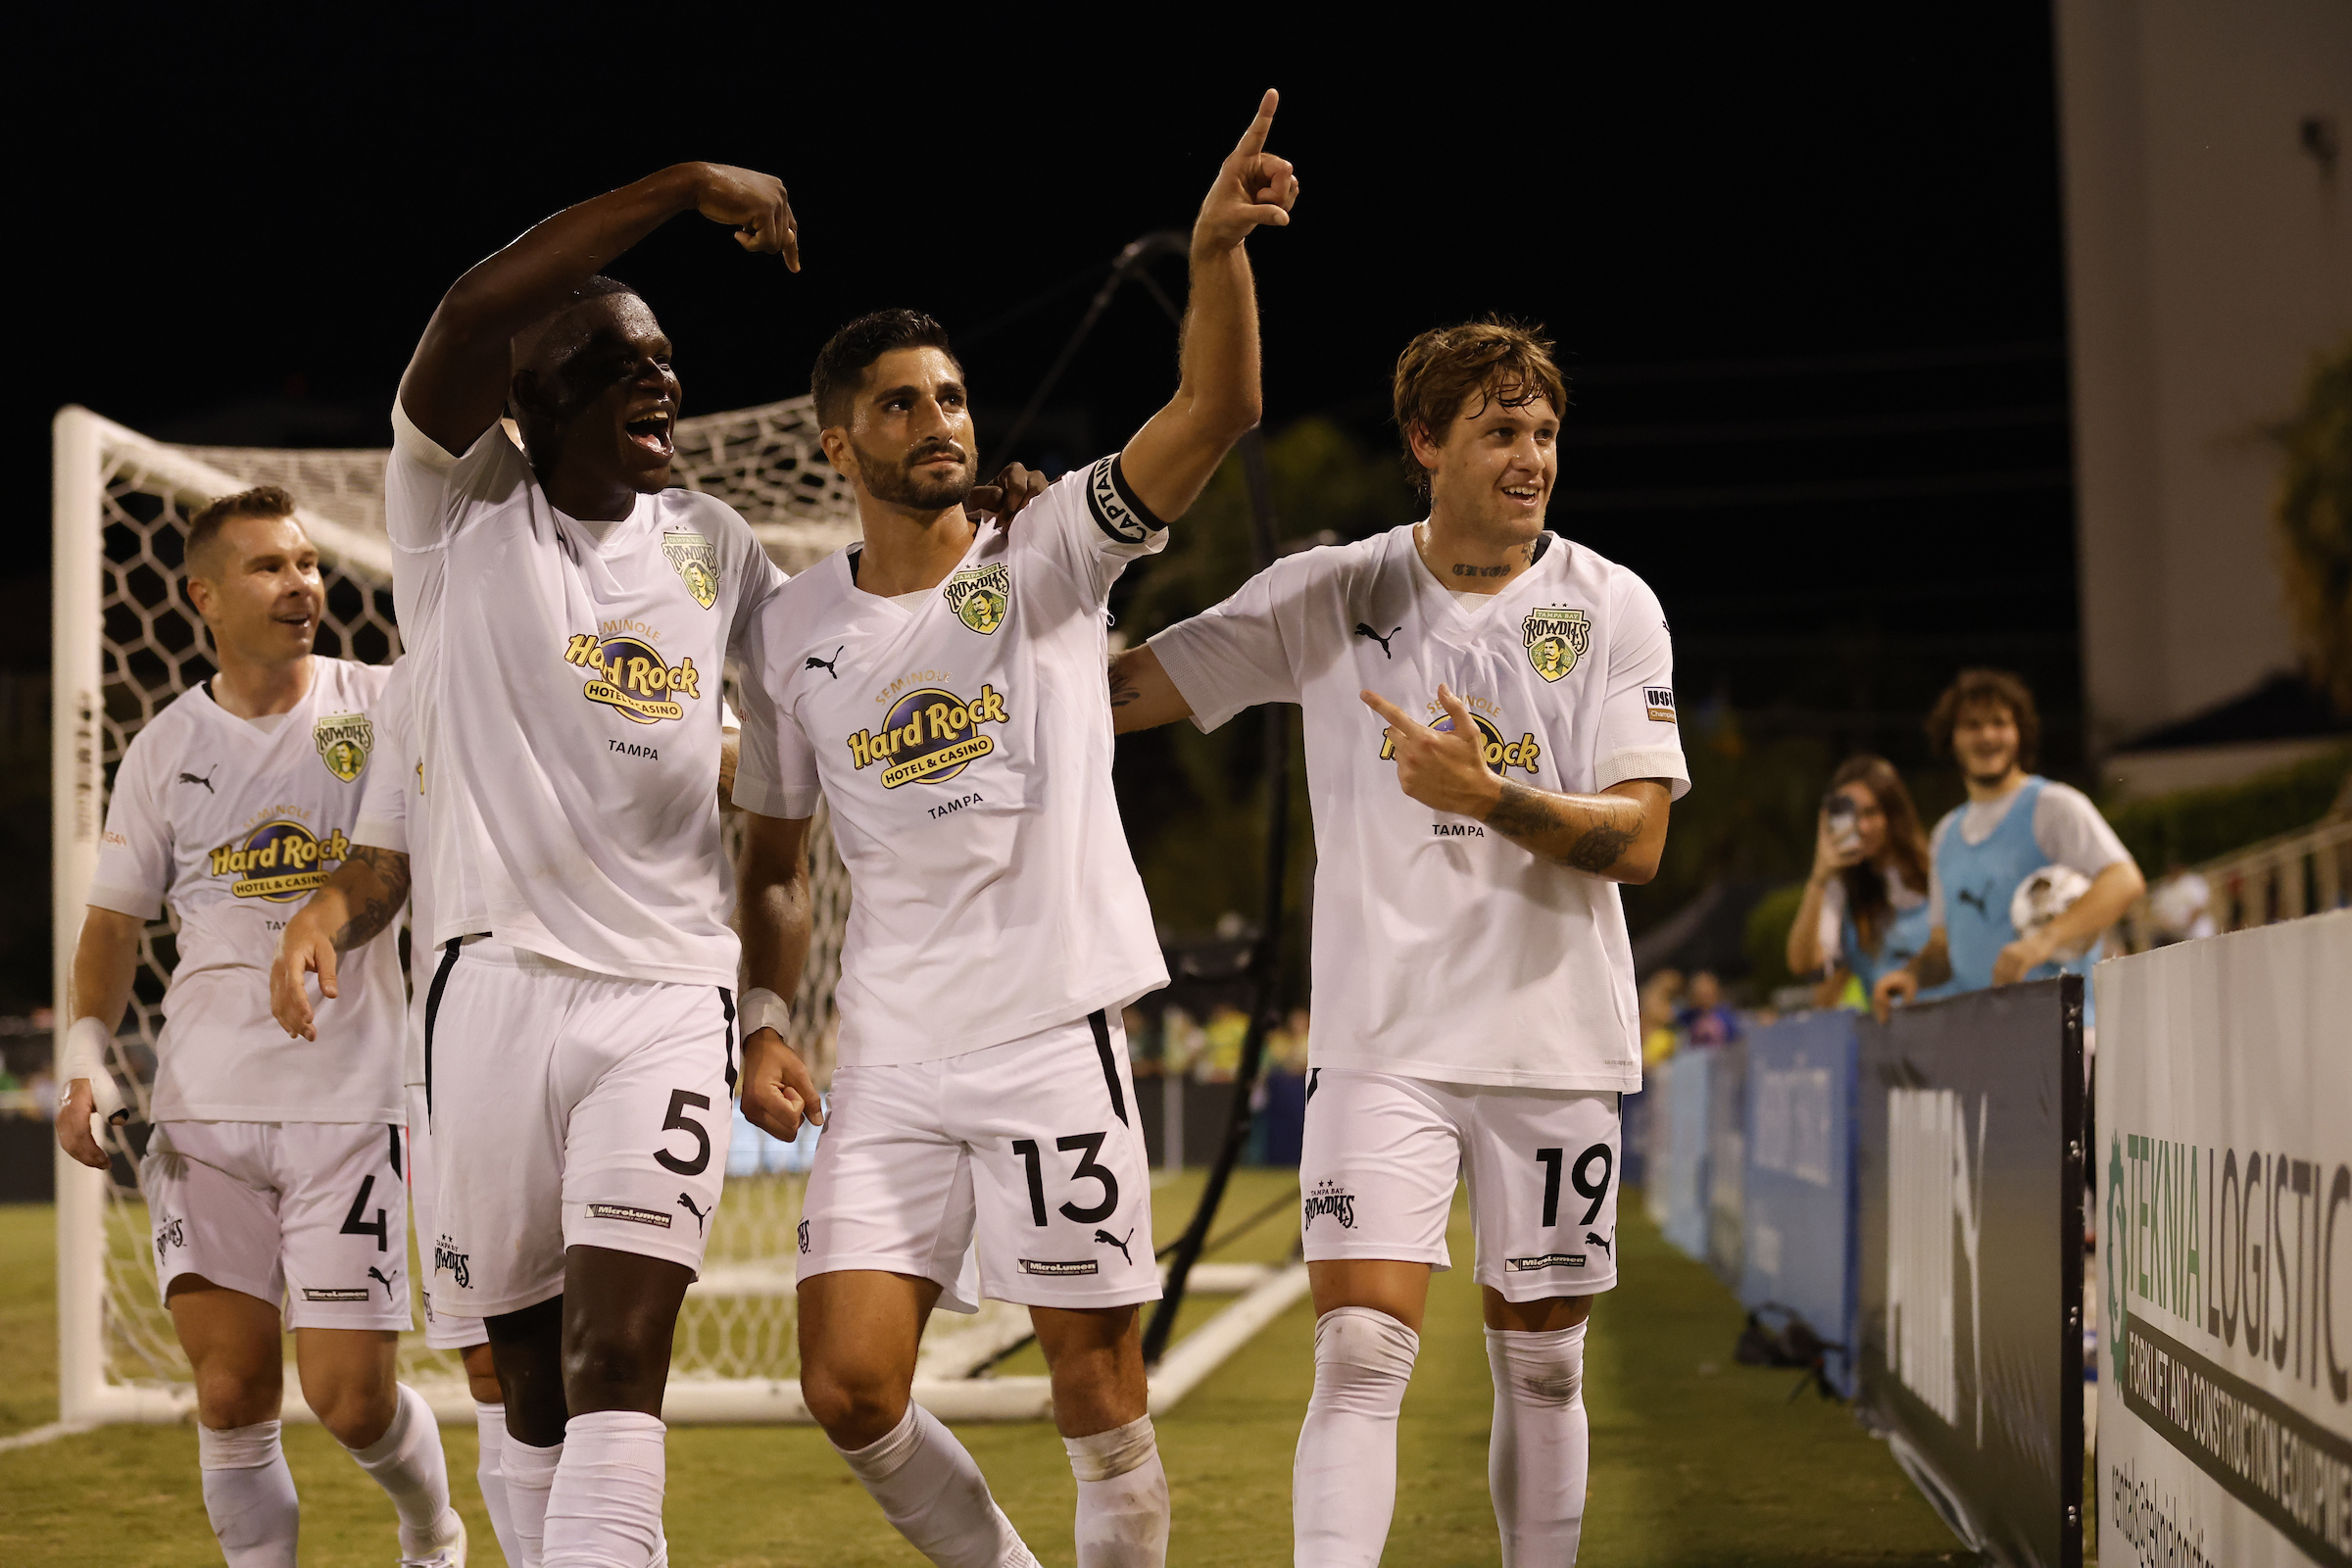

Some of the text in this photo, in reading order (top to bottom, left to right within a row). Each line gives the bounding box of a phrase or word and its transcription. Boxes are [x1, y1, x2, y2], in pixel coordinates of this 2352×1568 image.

[1096, 458, 1147, 541] CAPTAIN
[982, 565, 997, 575] BAY
[947, 567, 1009, 611] ROWDIES
[598, 618, 662, 643] MINOLE
[1526, 618, 1588, 653] ROWDIES
[564, 634, 701, 700] Had Rock
[589, 684, 627, 703] HOTEL
[875, 669, 953, 707] SEMINOLE
[1426, 694, 1501, 718] SEINOLE
[847, 684, 1010, 770] Hard Rock
[608, 739, 660, 760] TAMPA
[885, 740, 988, 784] HOTEL & CASINO
[927, 792, 984, 820] TAMPA
[1432, 824, 1486, 838] TAMPA
[209, 828, 351, 877] Hard Rock
[236, 881, 272, 894] HOTEL
[273, 880, 282, 889] &
[653, 1089, 710, 1176] 5
[1011, 1131, 1119, 1227] 13
[1536, 1143, 1613, 1228] 19
[339, 1175, 388, 1252] 4
[598, 1206, 670, 1223] MicroLumen
[1304, 1196, 1354, 1232] ROWDIES
[2128, 1133, 2201, 1329] TEKNIA
[1030, 1261, 1096, 1271] MicroLumen
[1522, 1254, 1584, 1267] MicroLumen
[2129, 1330, 2169, 1417] FORKLIFT
[2171, 1358, 2189, 1433] AND
[2192, 1372, 2279, 1501] CONSTRUCTION
